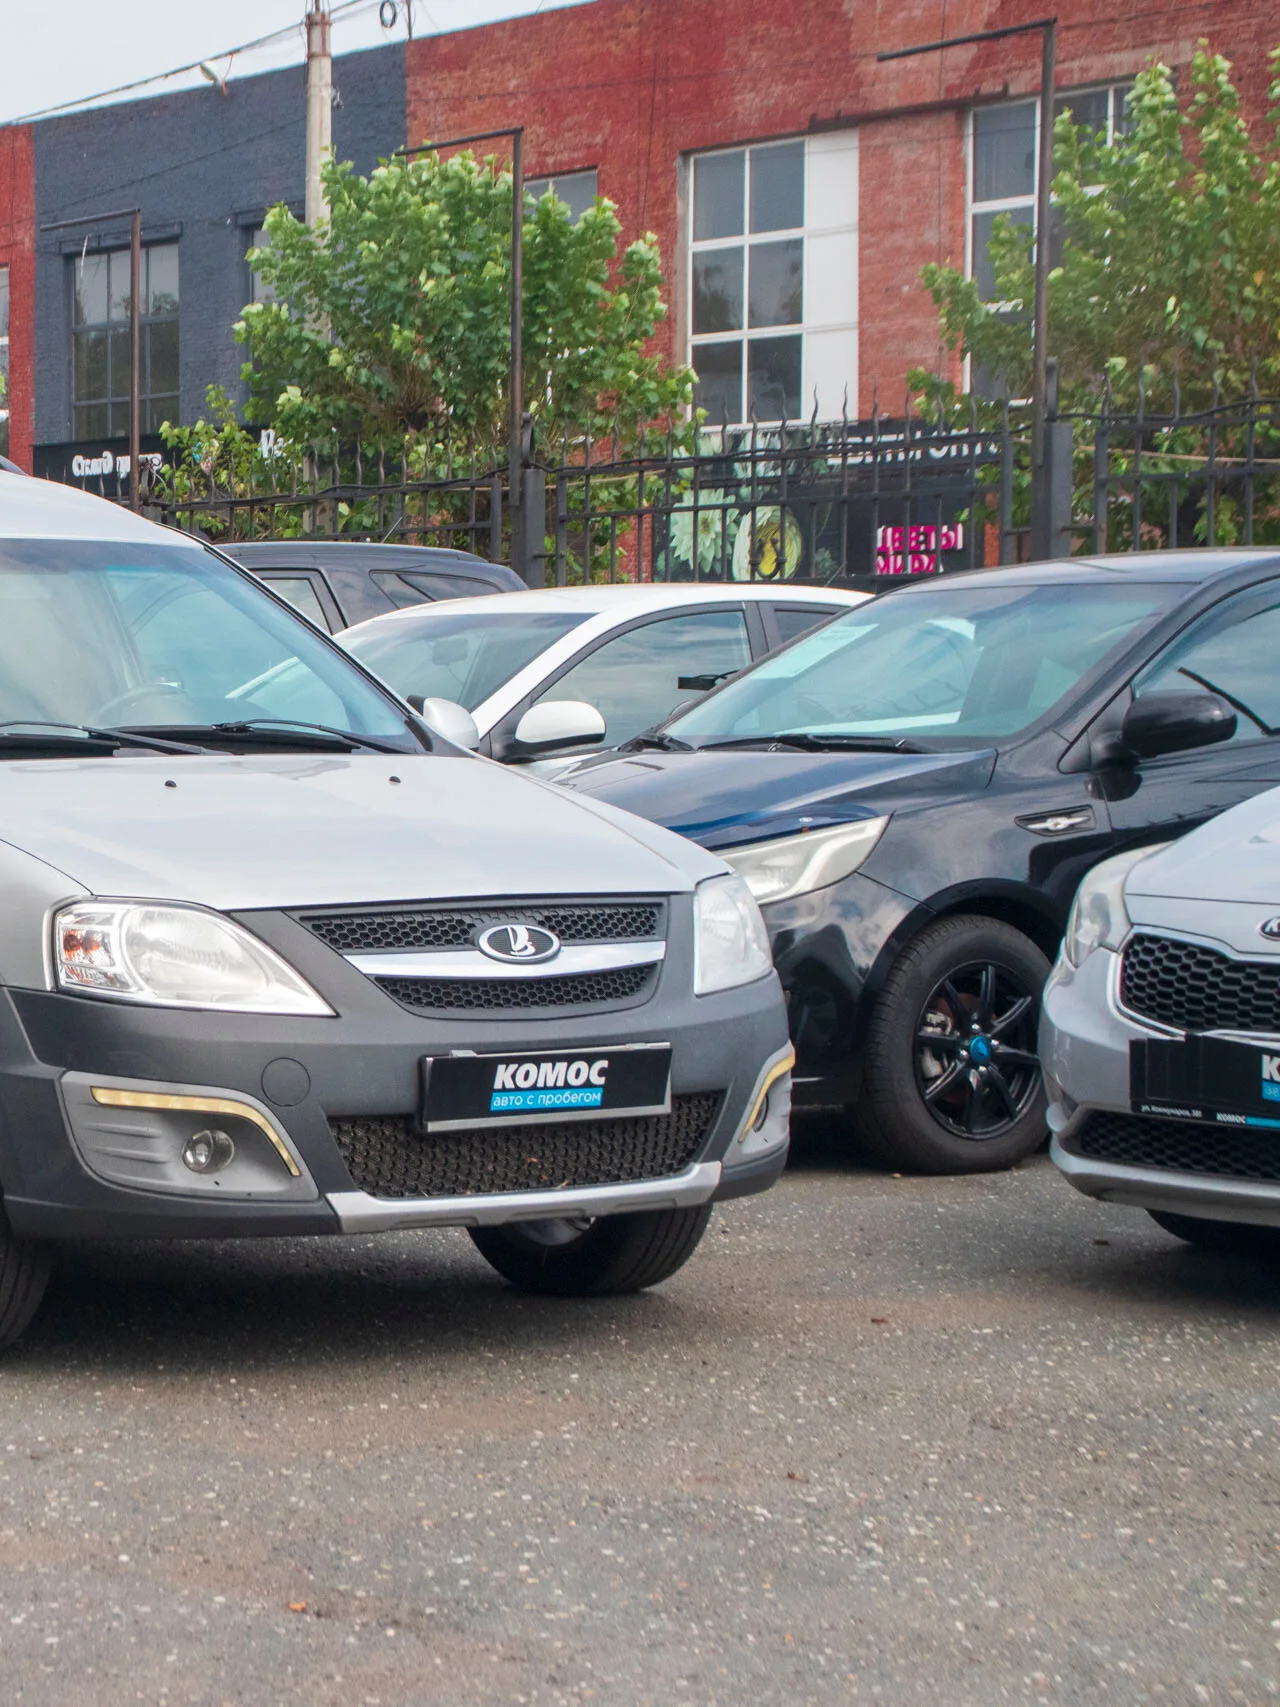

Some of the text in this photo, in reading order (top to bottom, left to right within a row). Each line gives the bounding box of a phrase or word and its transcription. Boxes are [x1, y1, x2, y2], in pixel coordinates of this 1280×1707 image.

[493, 1060, 609, 1090] КОМОС
[493, 1091, 601, 1107] авто с пробегом
